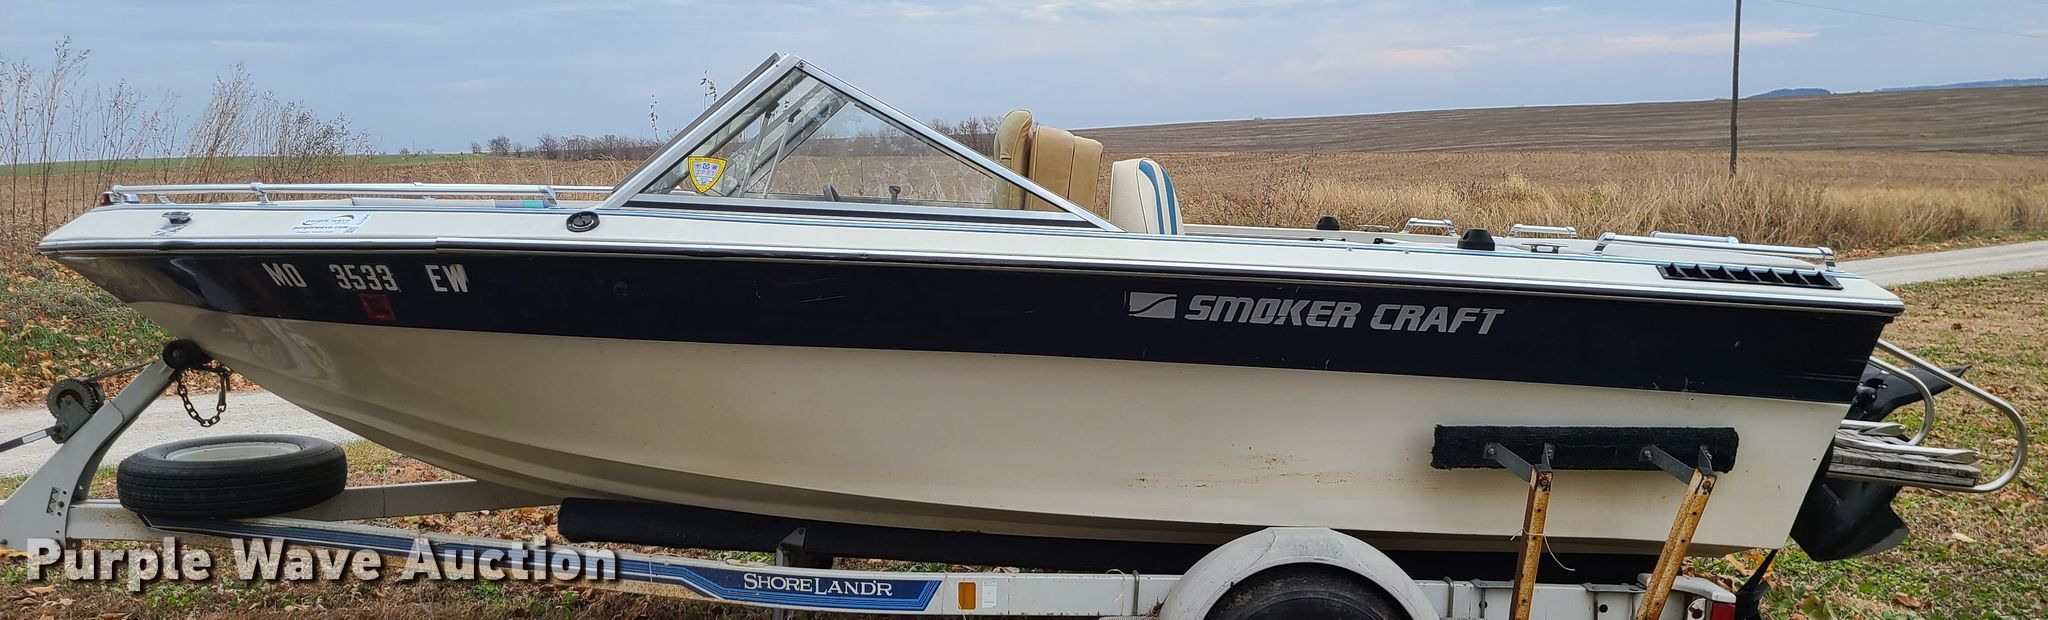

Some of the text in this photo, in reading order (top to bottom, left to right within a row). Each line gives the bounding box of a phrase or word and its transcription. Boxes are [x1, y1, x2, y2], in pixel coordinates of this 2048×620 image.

[262, 263, 469, 292] MO 3533 EW
[1184, 295, 1505, 334] SMOKER CRAFT
